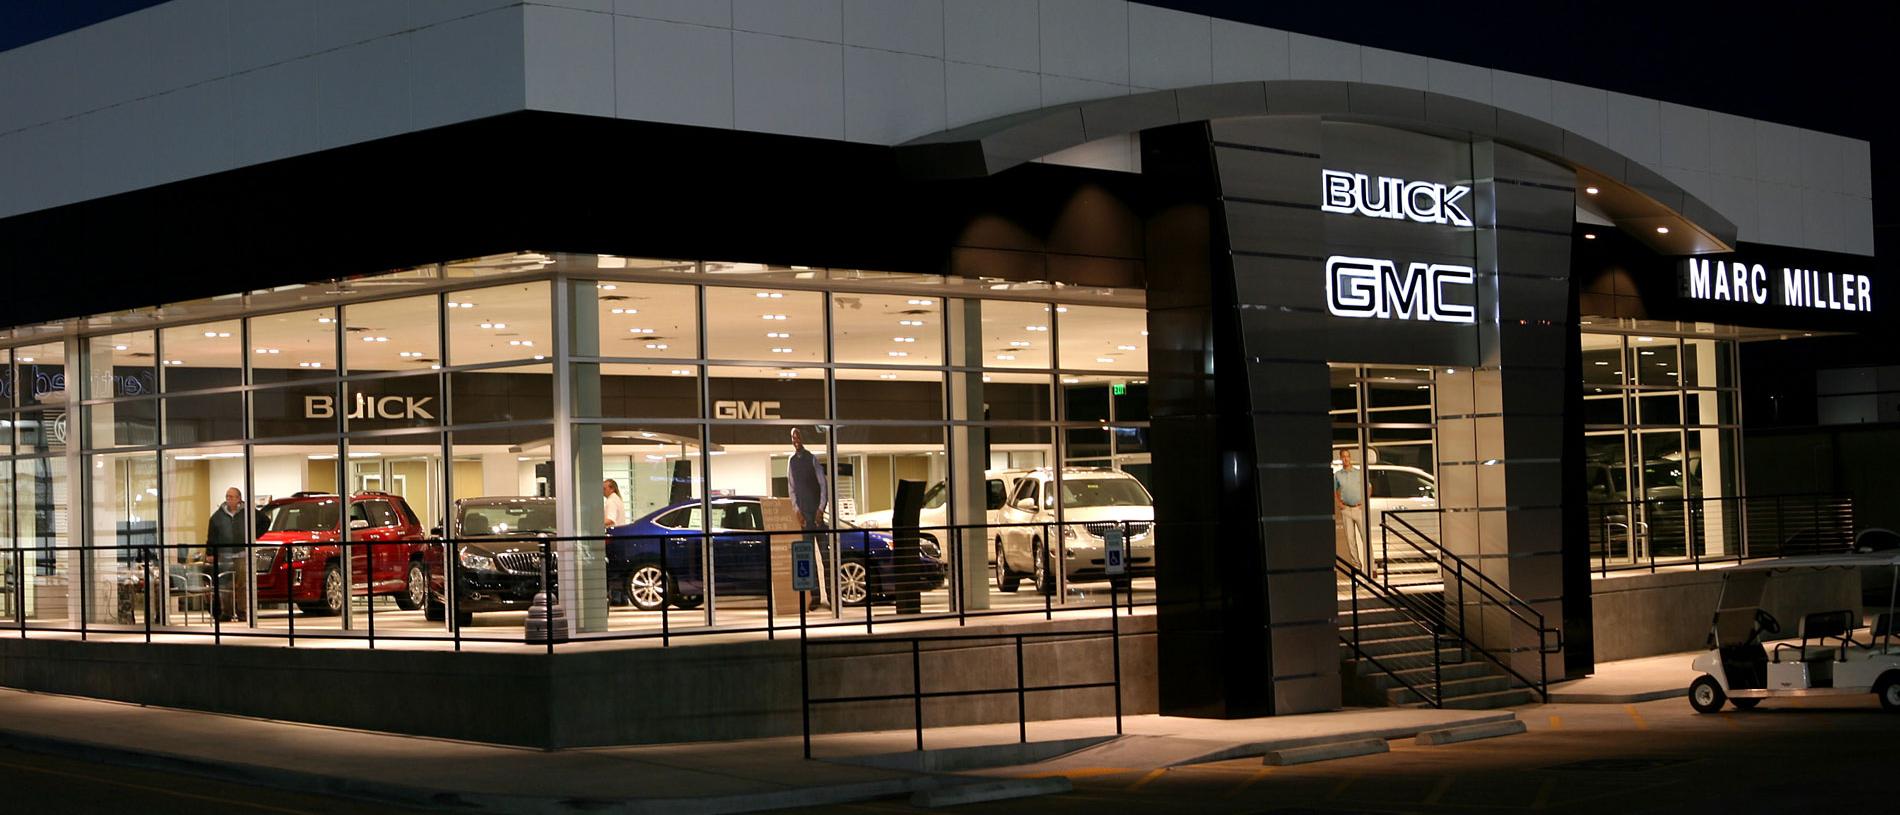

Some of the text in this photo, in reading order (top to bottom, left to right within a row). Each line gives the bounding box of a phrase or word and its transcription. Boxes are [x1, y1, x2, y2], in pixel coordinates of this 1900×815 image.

[1321, 169, 1473, 227] BUICK
[1326, 255, 1475, 323] GMC
[1689, 257, 1872, 312] MARC MILLER
[305, 393, 435, 419] BUICK
[715, 400, 781, 420] GMC
